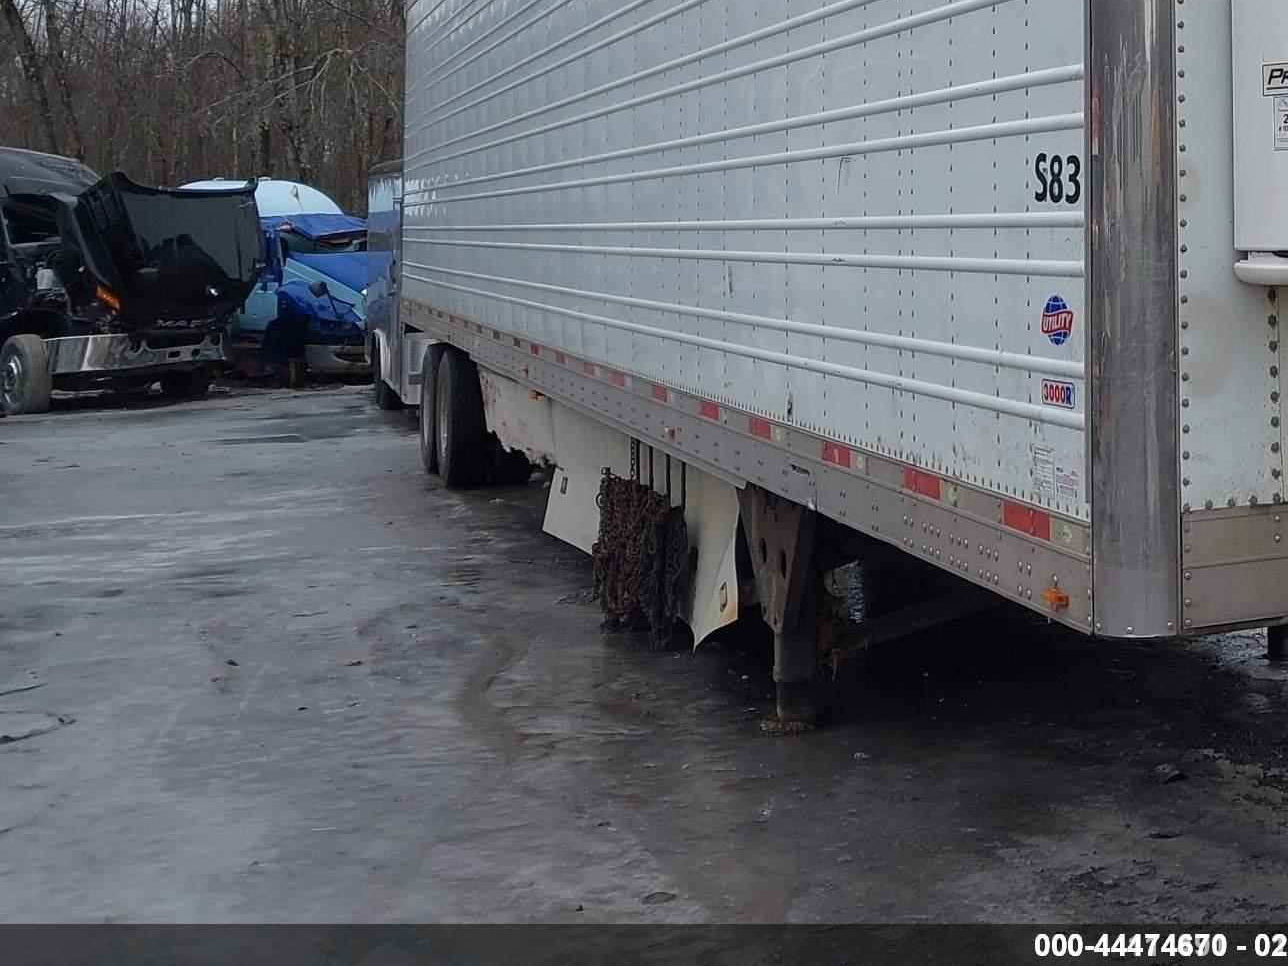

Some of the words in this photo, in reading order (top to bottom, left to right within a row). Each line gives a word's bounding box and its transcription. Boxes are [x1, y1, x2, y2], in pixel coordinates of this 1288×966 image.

[1035, 152, 1082, 204] S83
[1042, 312, 1071, 332] UTILITY
[1043, 383, 1073, 406] 3000R
